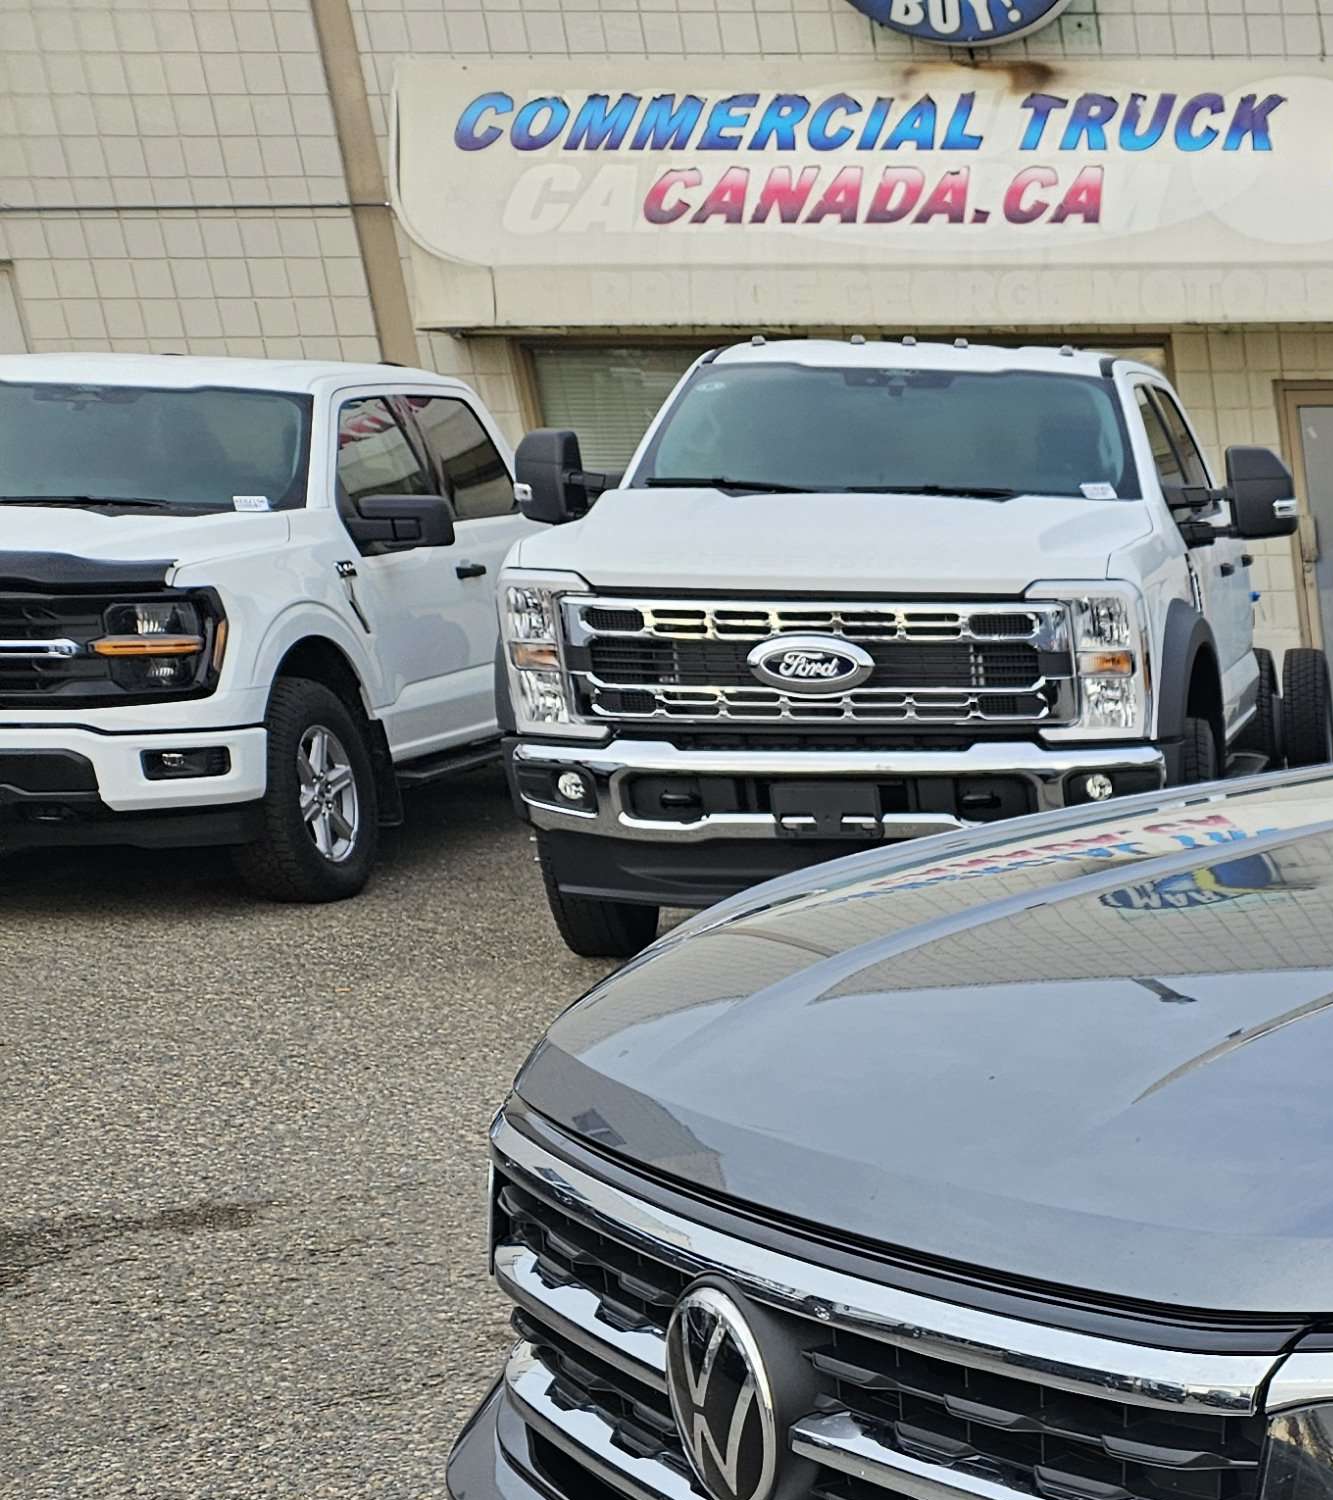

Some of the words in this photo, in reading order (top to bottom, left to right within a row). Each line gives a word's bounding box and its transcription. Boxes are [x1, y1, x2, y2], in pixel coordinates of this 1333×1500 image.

[453, 91, 984, 152] COMMERCIAL
[1018, 91, 1289, 152] TRUCK
[642, 165, 1105, 225] CANADA.CA
[778, 651, 841, 677] Ford
